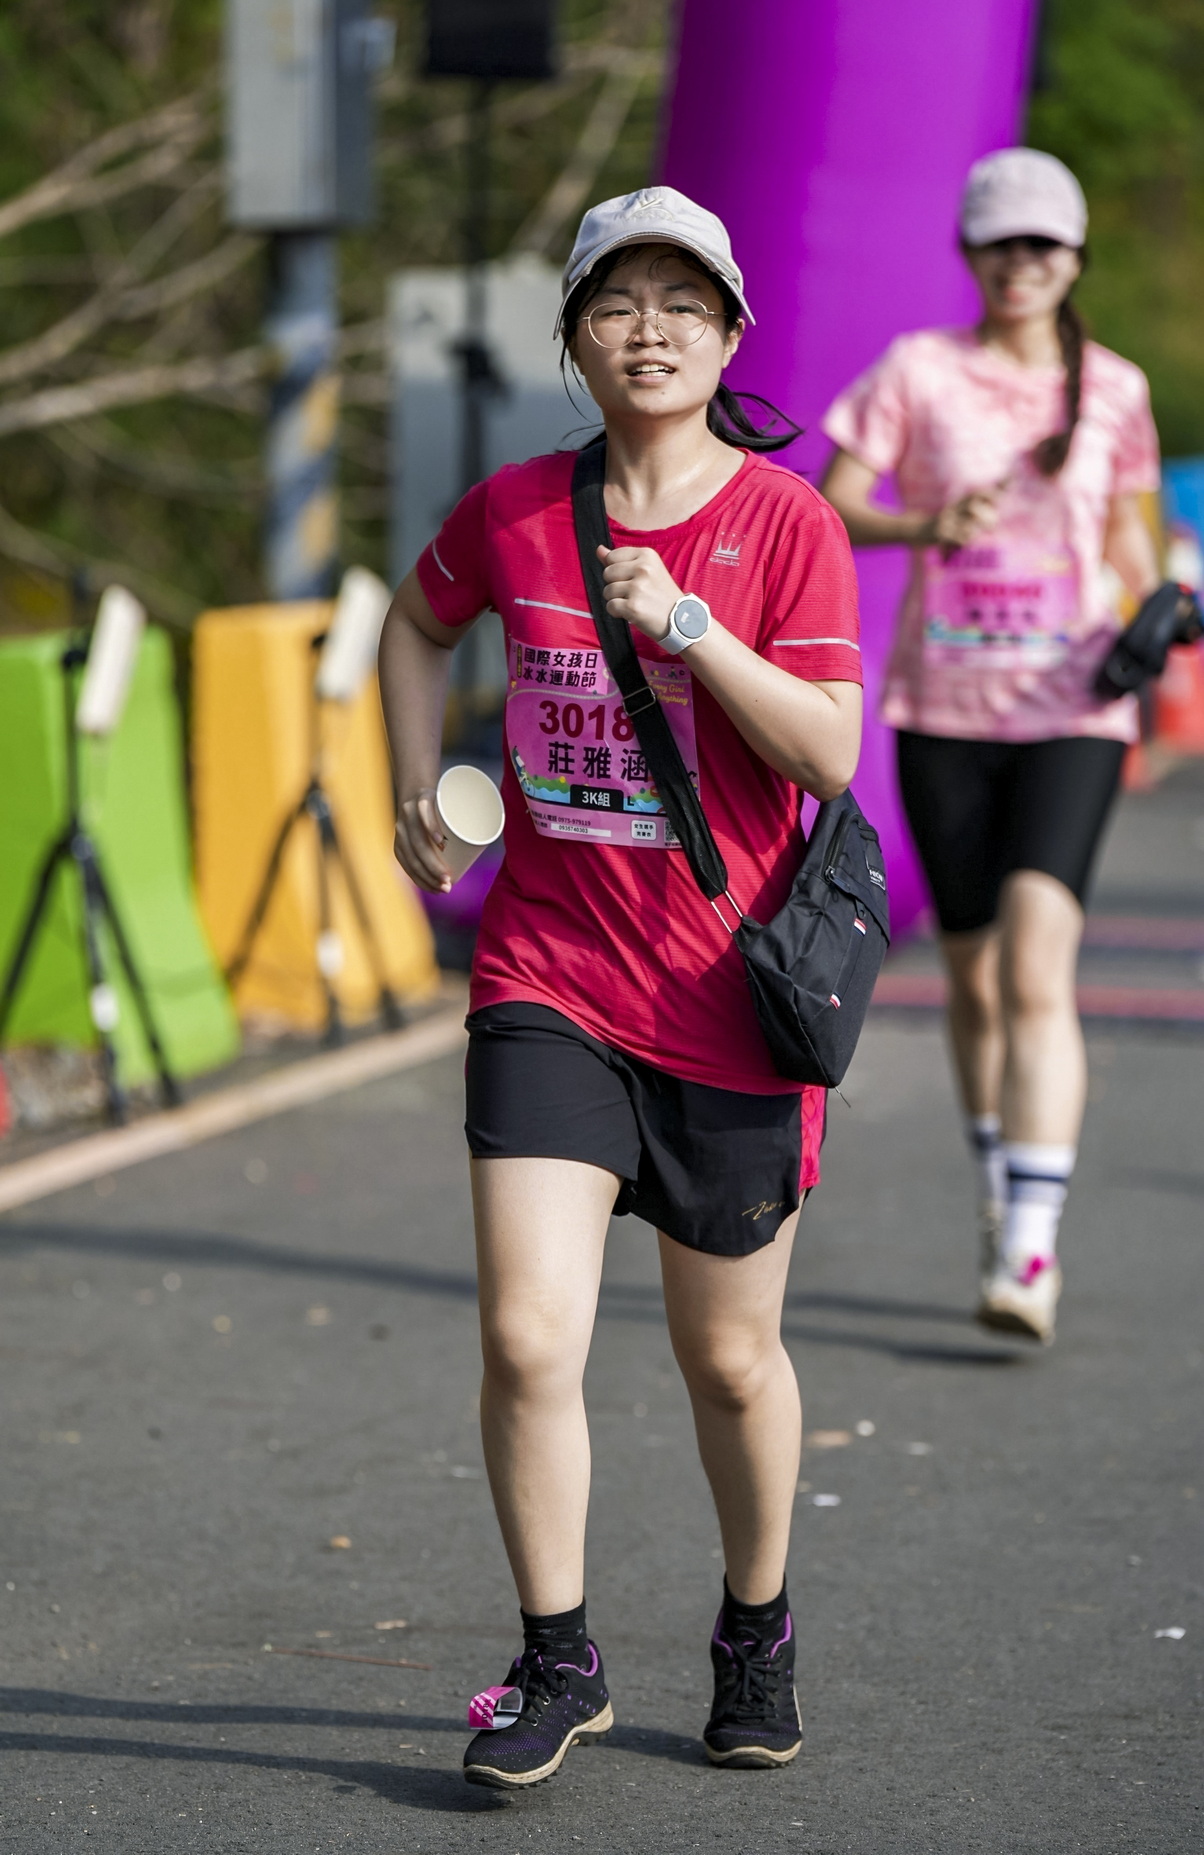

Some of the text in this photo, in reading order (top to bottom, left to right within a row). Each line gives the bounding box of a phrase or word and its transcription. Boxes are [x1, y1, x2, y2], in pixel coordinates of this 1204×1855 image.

[524, 647, 598, 668] 國際女孩日
[523, 666, 597, 687] 水水運動節
[539, 700, 635, 742] 3018
[548, 741, 649, 782] 莊雅涵
[581, 791, 611, 807] 3K組
